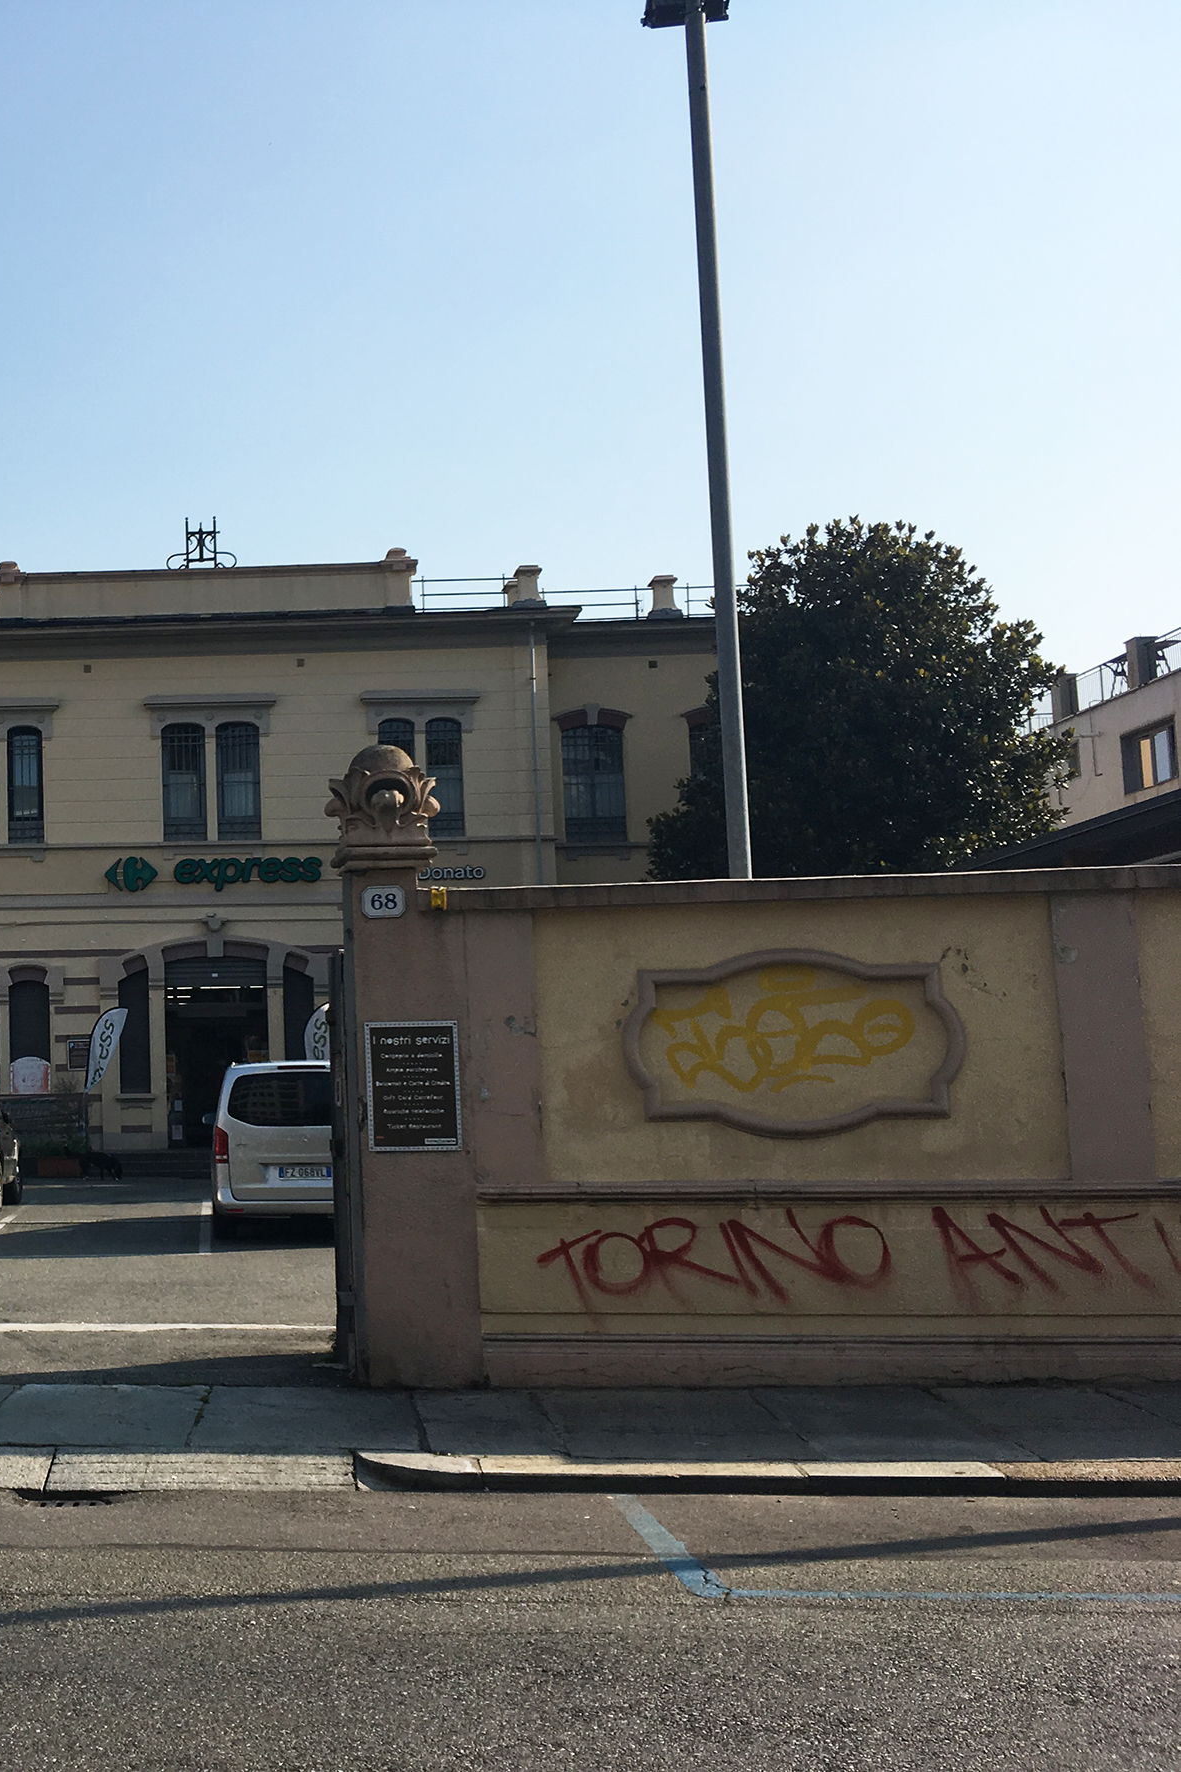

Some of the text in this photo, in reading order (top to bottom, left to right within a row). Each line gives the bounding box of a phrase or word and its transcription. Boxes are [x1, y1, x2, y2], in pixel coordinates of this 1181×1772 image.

[173, 856, 323, 892] express
[418, 864, 485, 880] Donato
[371, 892, 399, 911] 68
[380, 1035, 411, 1046] nostri
[415, 1034, 451, 1046] servizi
[537, 1207, 891, 1316] TORINO
